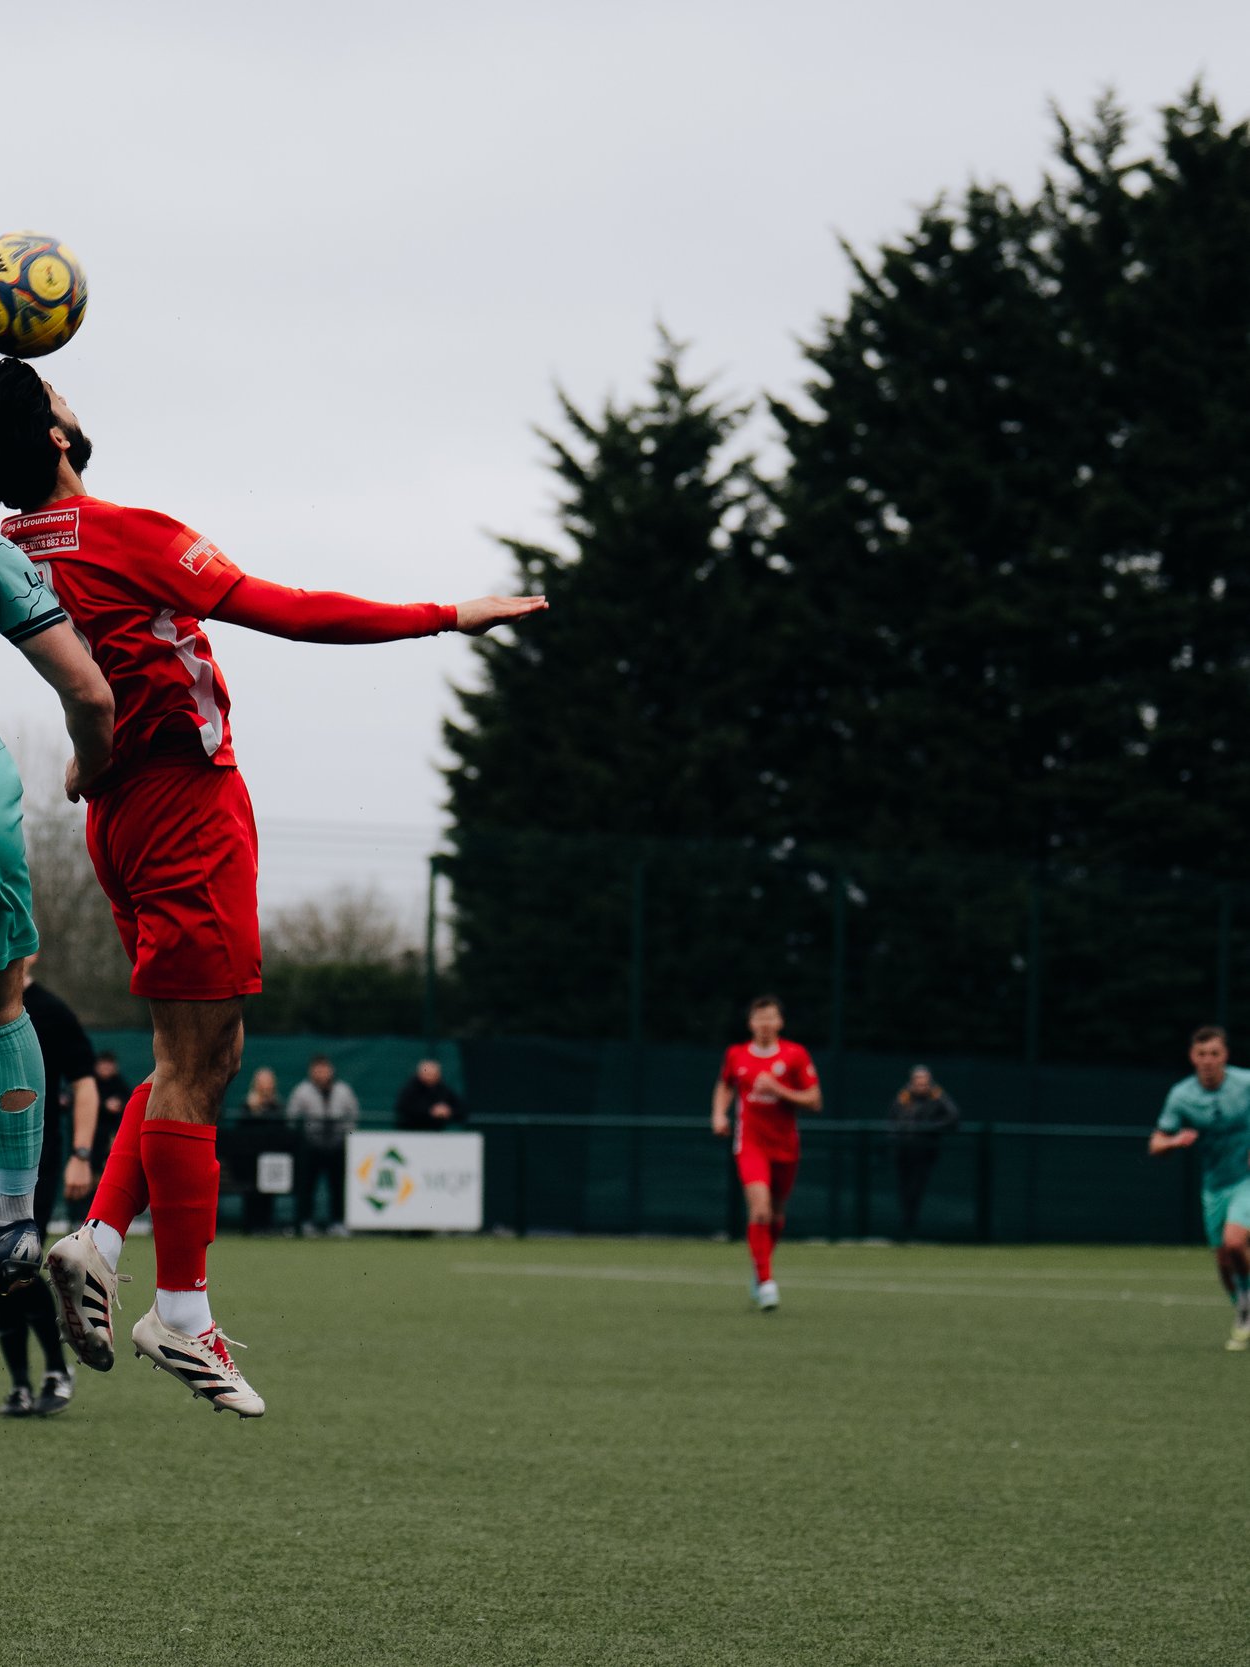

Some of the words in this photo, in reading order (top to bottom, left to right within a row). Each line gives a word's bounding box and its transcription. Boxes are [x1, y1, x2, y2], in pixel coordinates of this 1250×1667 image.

[16, 520, 22, 529] &
[23, 512, 75, 527] Groundworks
[46, 538, 60, 547] 882
[61, 536, 75, 545] 424
